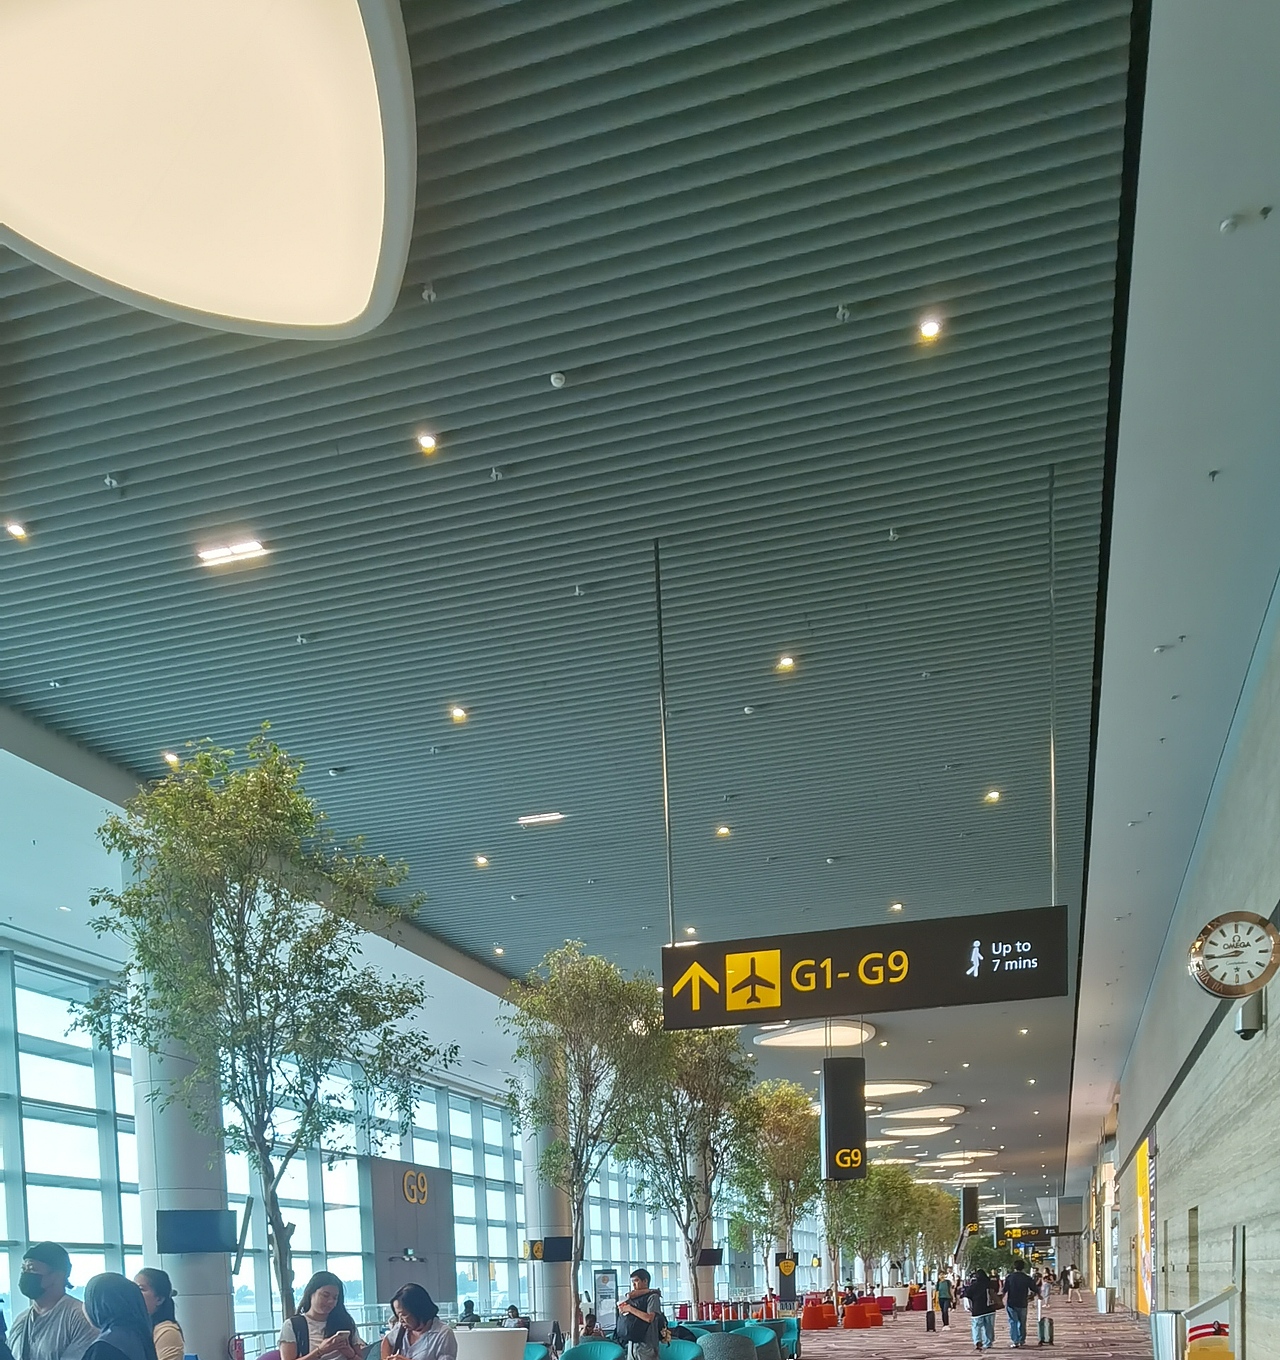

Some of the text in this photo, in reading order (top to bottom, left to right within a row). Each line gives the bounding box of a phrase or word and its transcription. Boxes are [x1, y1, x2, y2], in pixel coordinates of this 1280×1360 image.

[991, 940, 1032, 957] Up to
[1222, 941, 1251, 950] OMEGA
[991, 956, 1038, 972] 7 mins
[835, 1148, 862, 1168] G9
[403, 1169, 428, 1205] G9
[966, 1223, 979, 1232] G8
